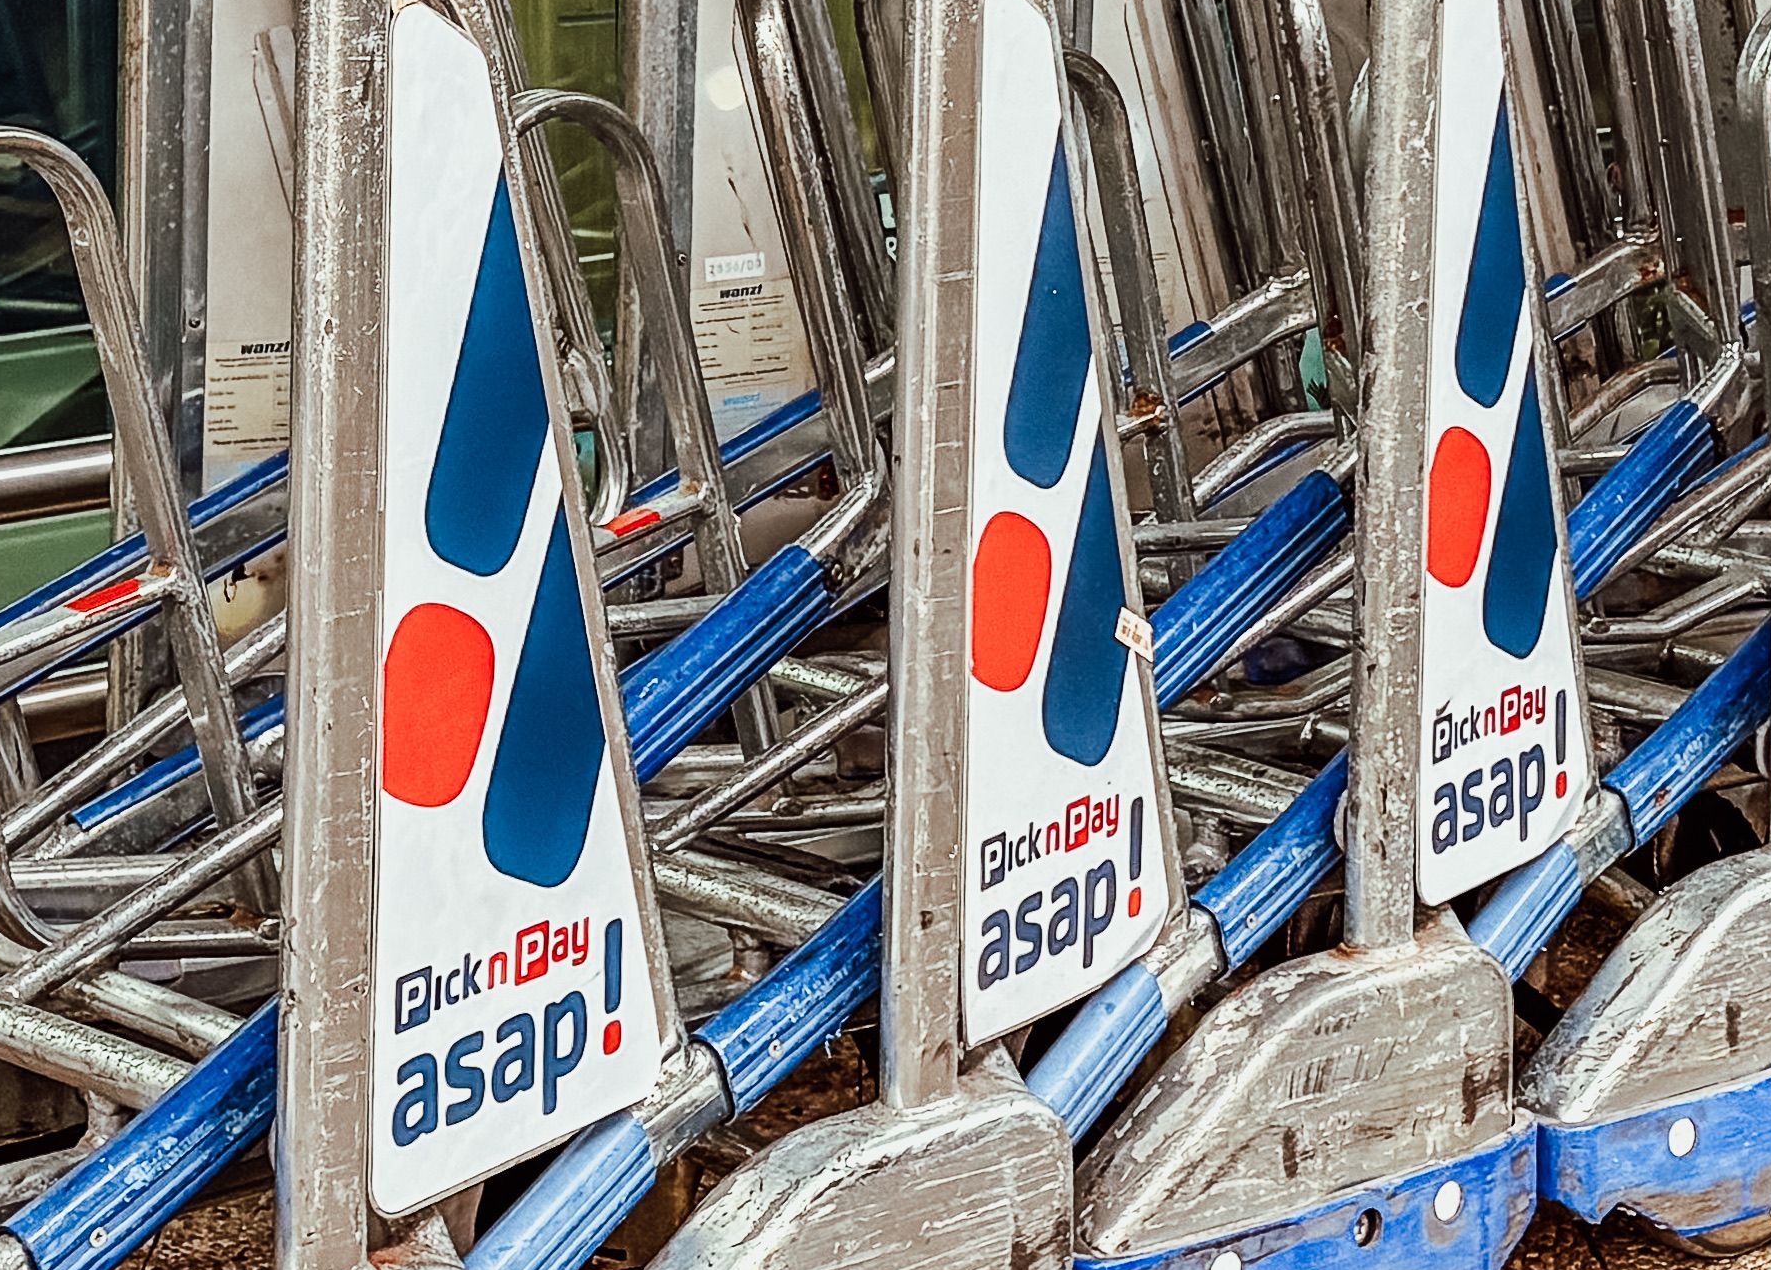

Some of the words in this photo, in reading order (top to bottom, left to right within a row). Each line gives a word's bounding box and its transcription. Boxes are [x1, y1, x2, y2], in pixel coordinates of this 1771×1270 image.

[719, 283, 763, 299] wanzl
[1431, 689, 1568, 855] asap!
[1432, 704, 1481, 765] Pick
[1483, 705, 1497, 737] n
[1499, 684, 1547, 736] Pay
[978, 795, 1144, 991] asap!
[980, 821, 1043, 892] Pick
[1045, 821, 1061, 855] n
[1064, 793, 1120, 853] Pay
[391, 917, 623, 1148] asap!
[394, 952, 483, 1035] Pick
[487, 950, 508, 990] n
[514, 916, 590, 987] Pay
